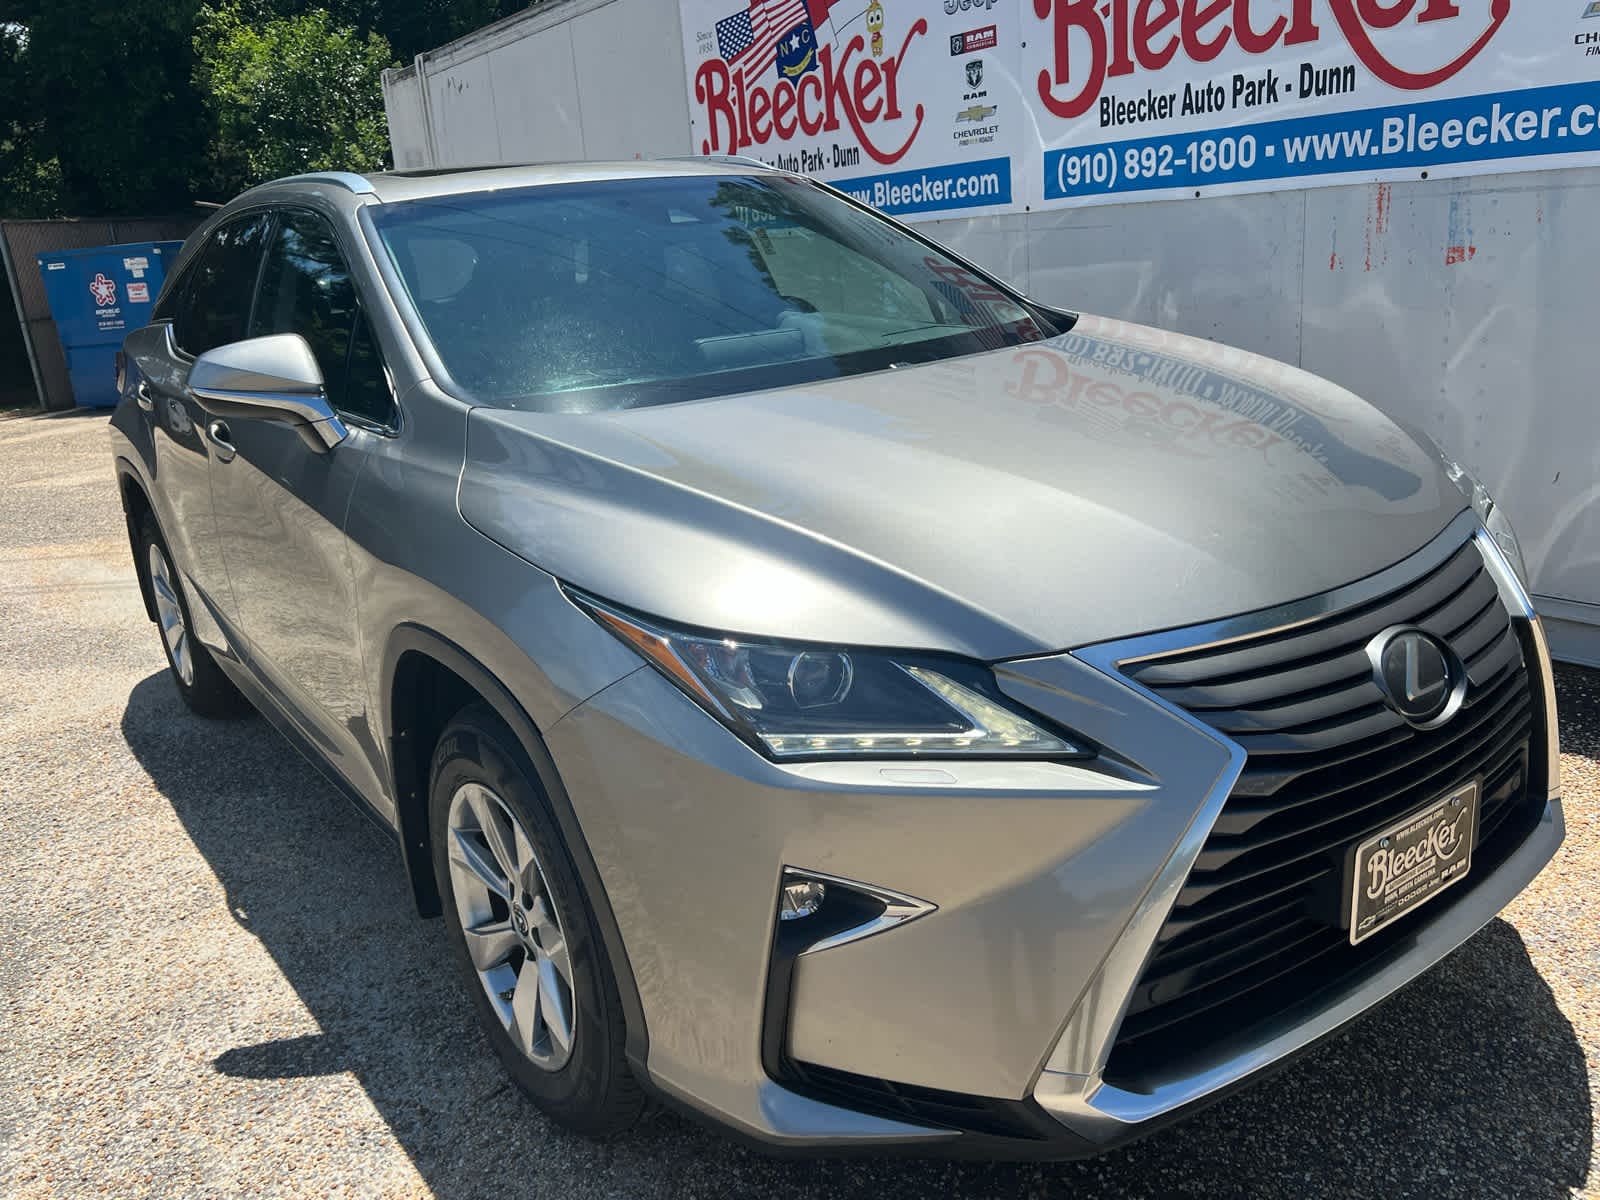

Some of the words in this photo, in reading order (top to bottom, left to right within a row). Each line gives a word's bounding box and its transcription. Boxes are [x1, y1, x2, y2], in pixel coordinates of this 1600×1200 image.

[966, 29, 994, 42] RAM
[1033, 0, 1511, 119] Bleec
[963, 90, 987, 101] RAM
[1099, 89, 1177, 128] Bleecker
[1181, 80, 1226, 117] Auto
[1232, 69, 1280, 109] Park
[1299, 62, 1356, 99] Dunn
[953, 125, 999, 140] CHEVROLET
[777, 153, 799, 173] Auto
[801, 147, 825, 173] Park
[833, 144, 860, 168] Dunn
[1057, 148, 1118, 193] (910)
[1123, 135, 1257, 180] 892-1800
[1283, 102, 1600, 164] www.Bleecker.c
